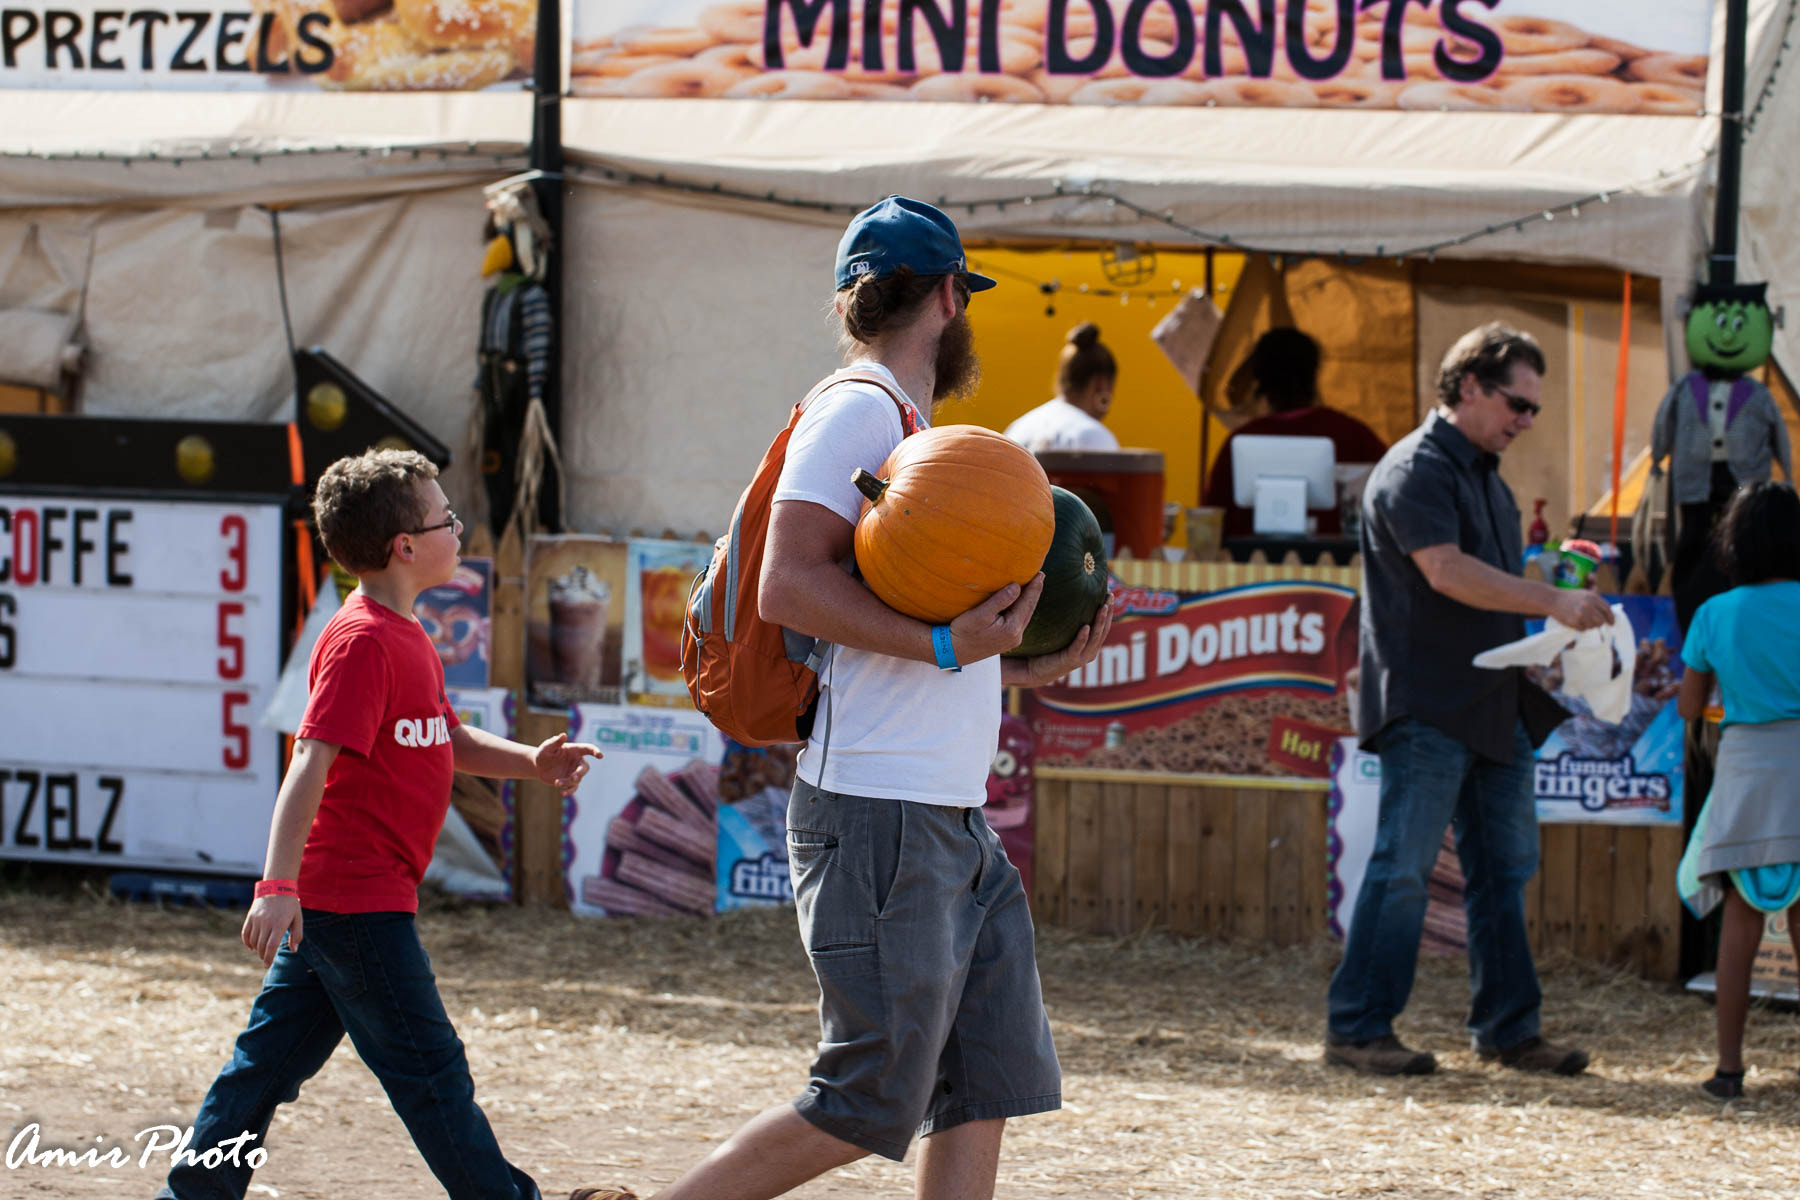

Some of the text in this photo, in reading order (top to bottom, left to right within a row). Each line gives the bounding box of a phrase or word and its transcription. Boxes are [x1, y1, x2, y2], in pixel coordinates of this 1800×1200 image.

[1, 10, 335, 73] PRETZELS
[763, 0, 1503, 83] MINI DONUTS
[219, 514, 247, 593] 3
[217, 602, 245, 680] 5
[1049, 604, 1325, 687] ini Donuts
[222, 691, 250, 770] 5
[1281, 729, 1322, 762] Hot
[1534, 761, 1668, 809] fingers
